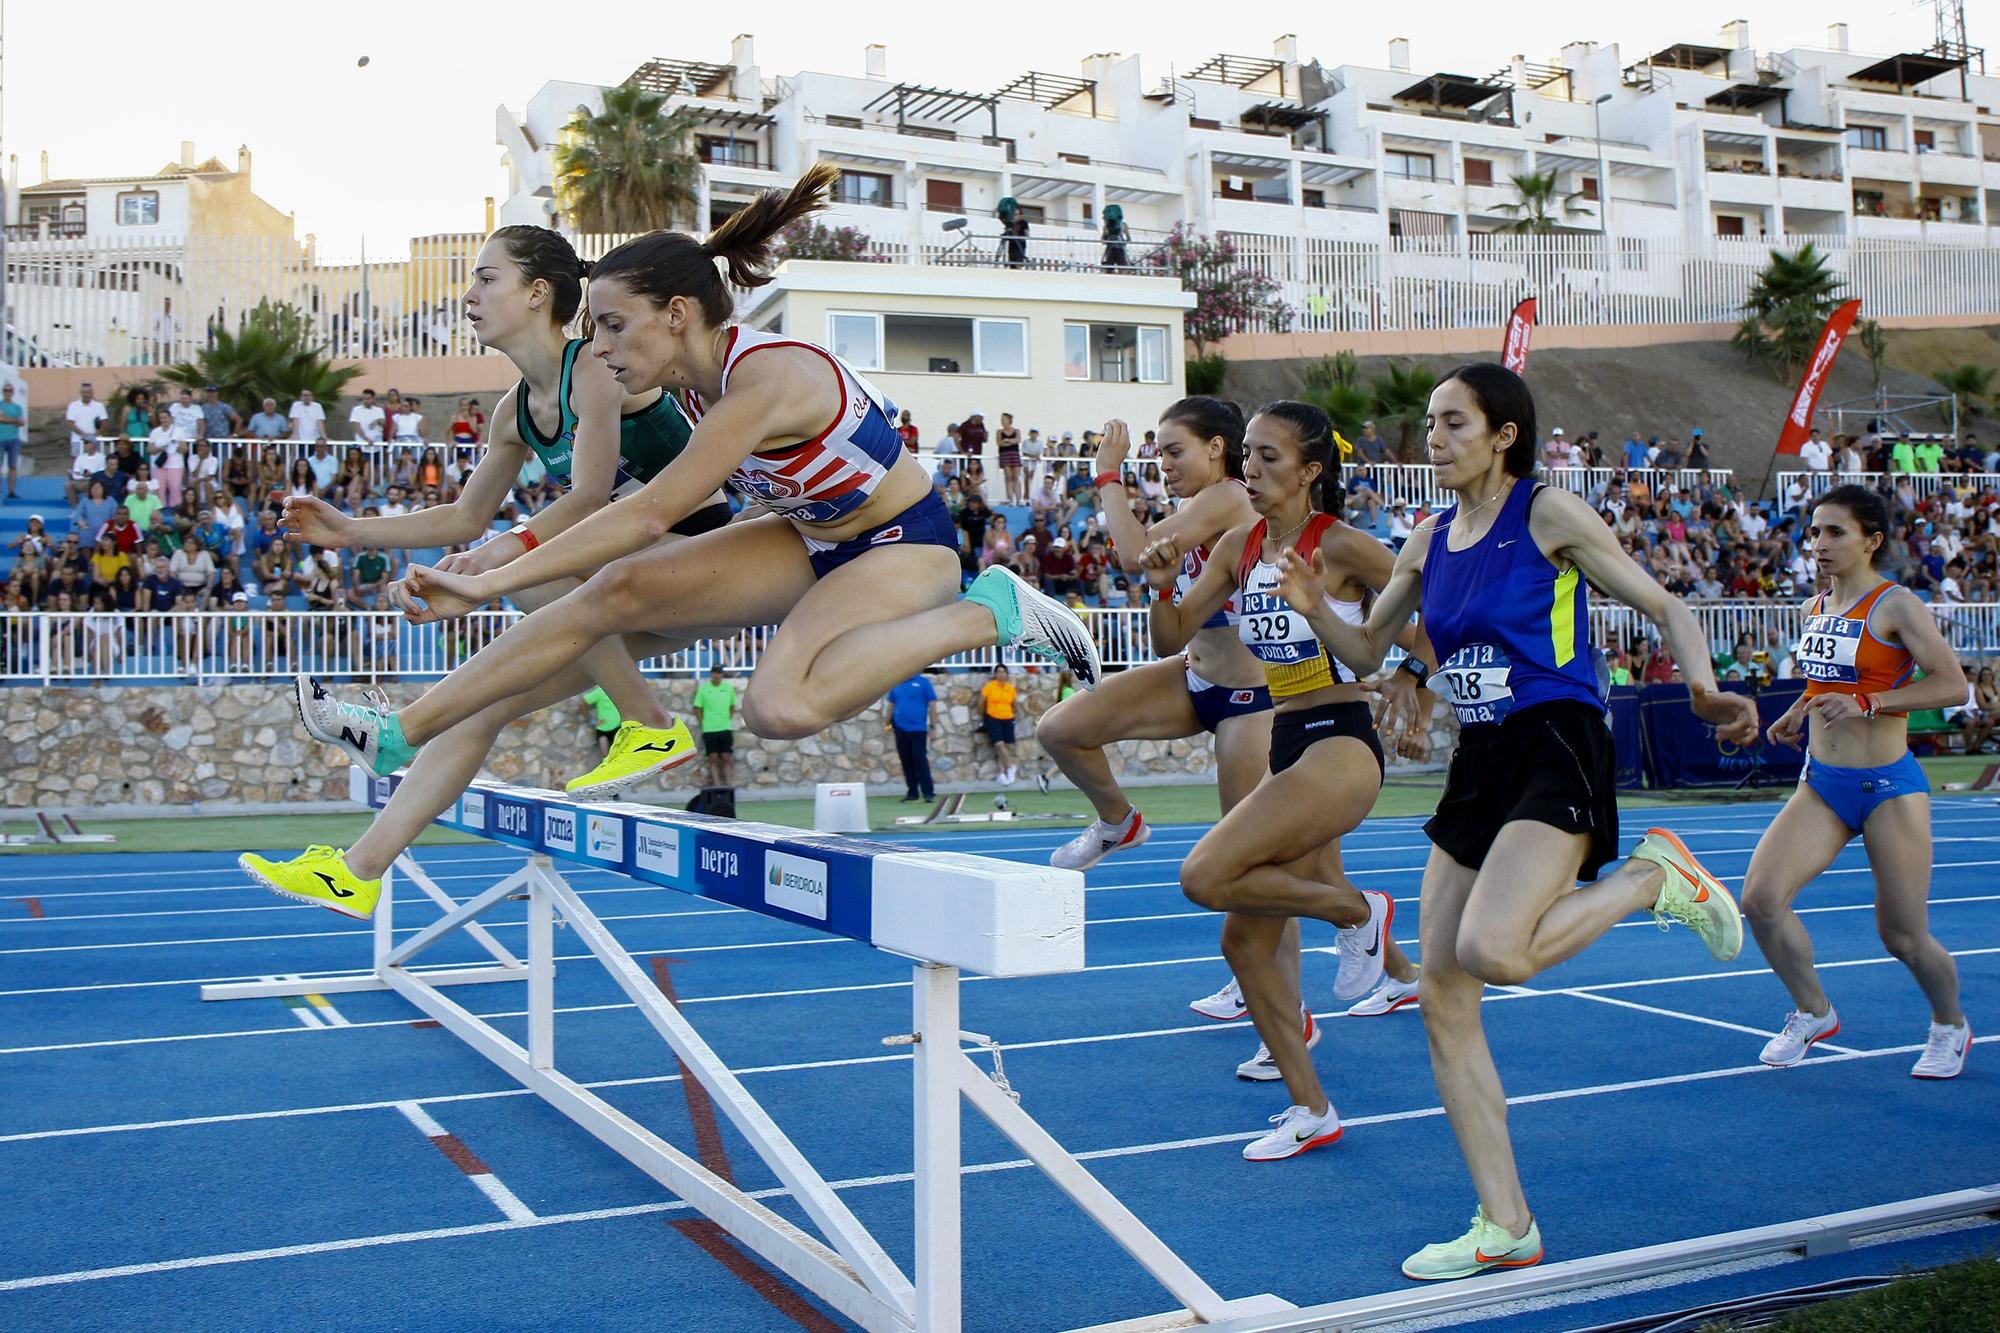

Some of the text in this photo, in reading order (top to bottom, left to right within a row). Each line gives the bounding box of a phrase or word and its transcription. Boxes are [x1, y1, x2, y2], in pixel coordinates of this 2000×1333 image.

[1245, 593, 1289, 613] nerj
[1248, 615, 1290, 641] 329
[1441, 645, 1494, 668] erja
[1801, 636, 1836, 660] 443
[1802, 662, 1841, 678] oma
[1456, 706, 1494, 723] oma
[498, 803, 527, 835] nerja
[701, 847, 738, 878] nerja
[784, 872, 823, 896] IBERDROLA
